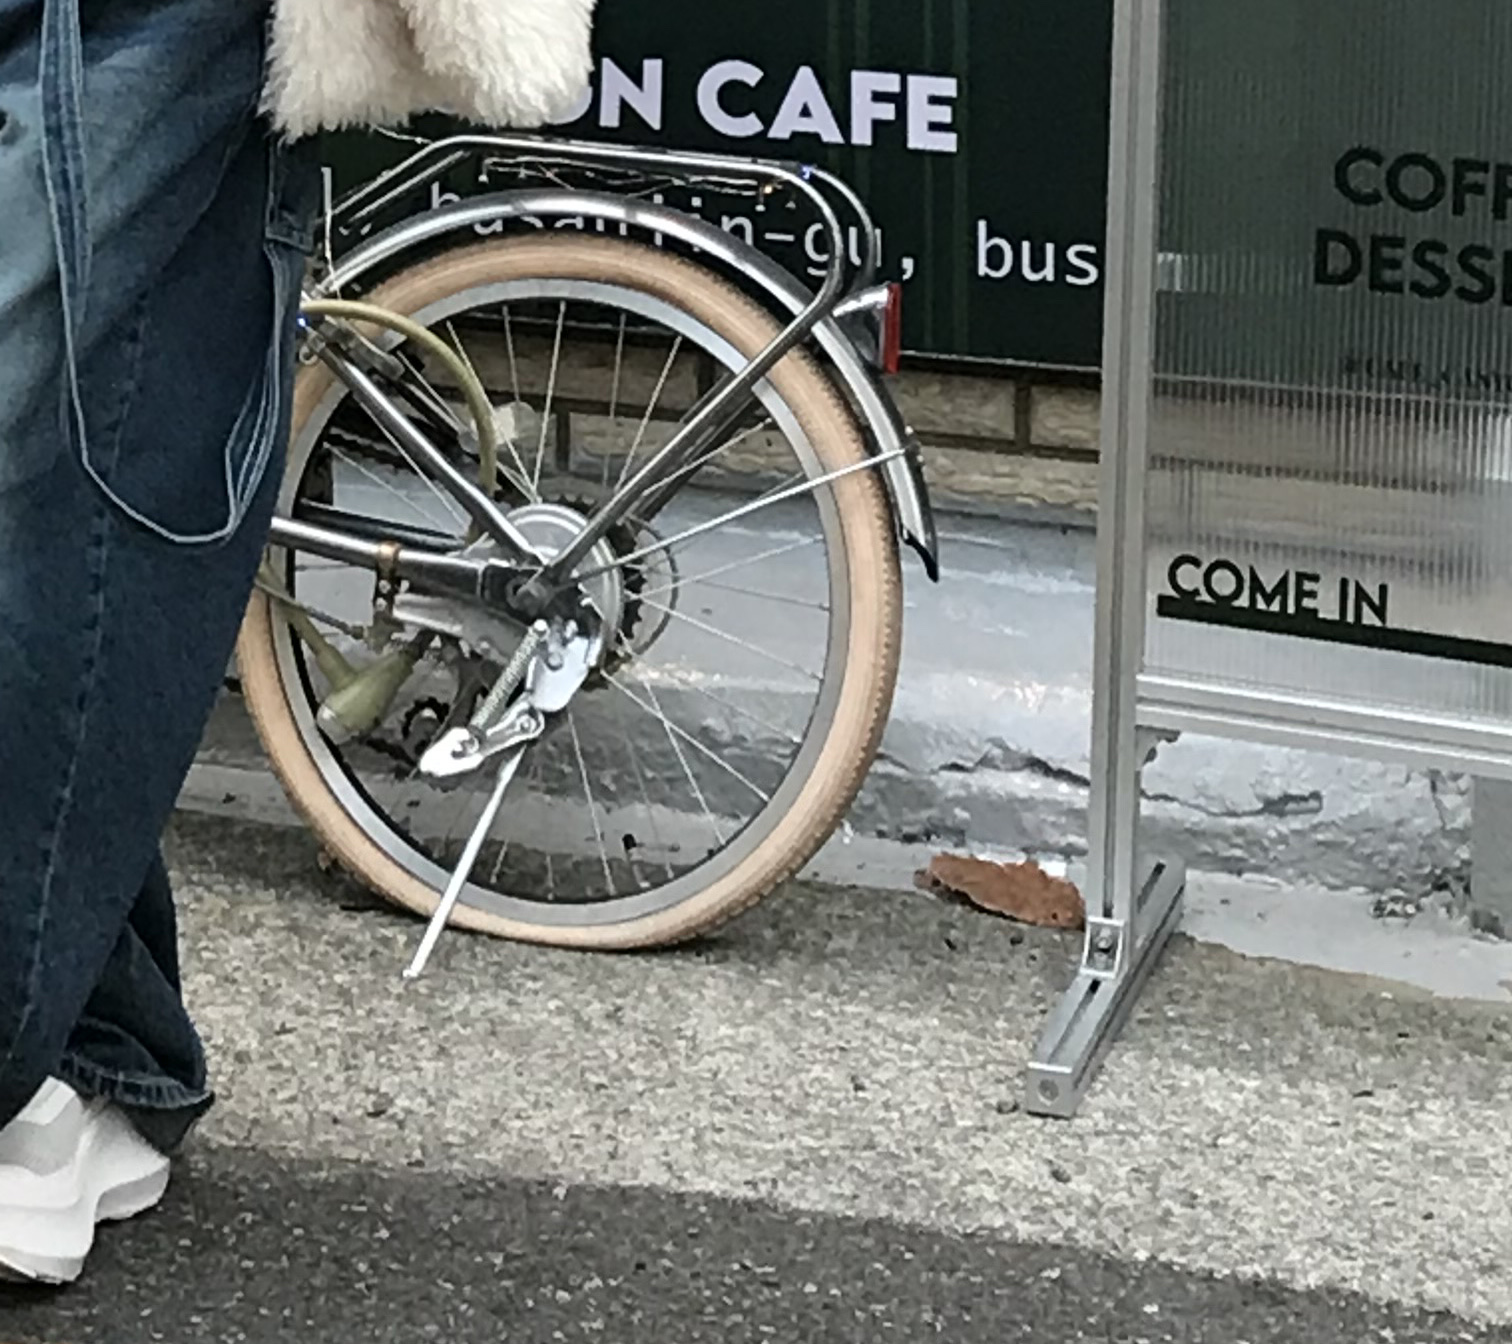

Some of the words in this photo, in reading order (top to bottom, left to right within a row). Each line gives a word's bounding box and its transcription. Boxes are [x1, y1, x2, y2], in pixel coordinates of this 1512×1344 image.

[696, 58, 958, 154] CAFE
[1314, 227, 1512, 307] DESS
[1167, 553, 1321, 619] COME
[1338, 576, 1388, 627] IN
